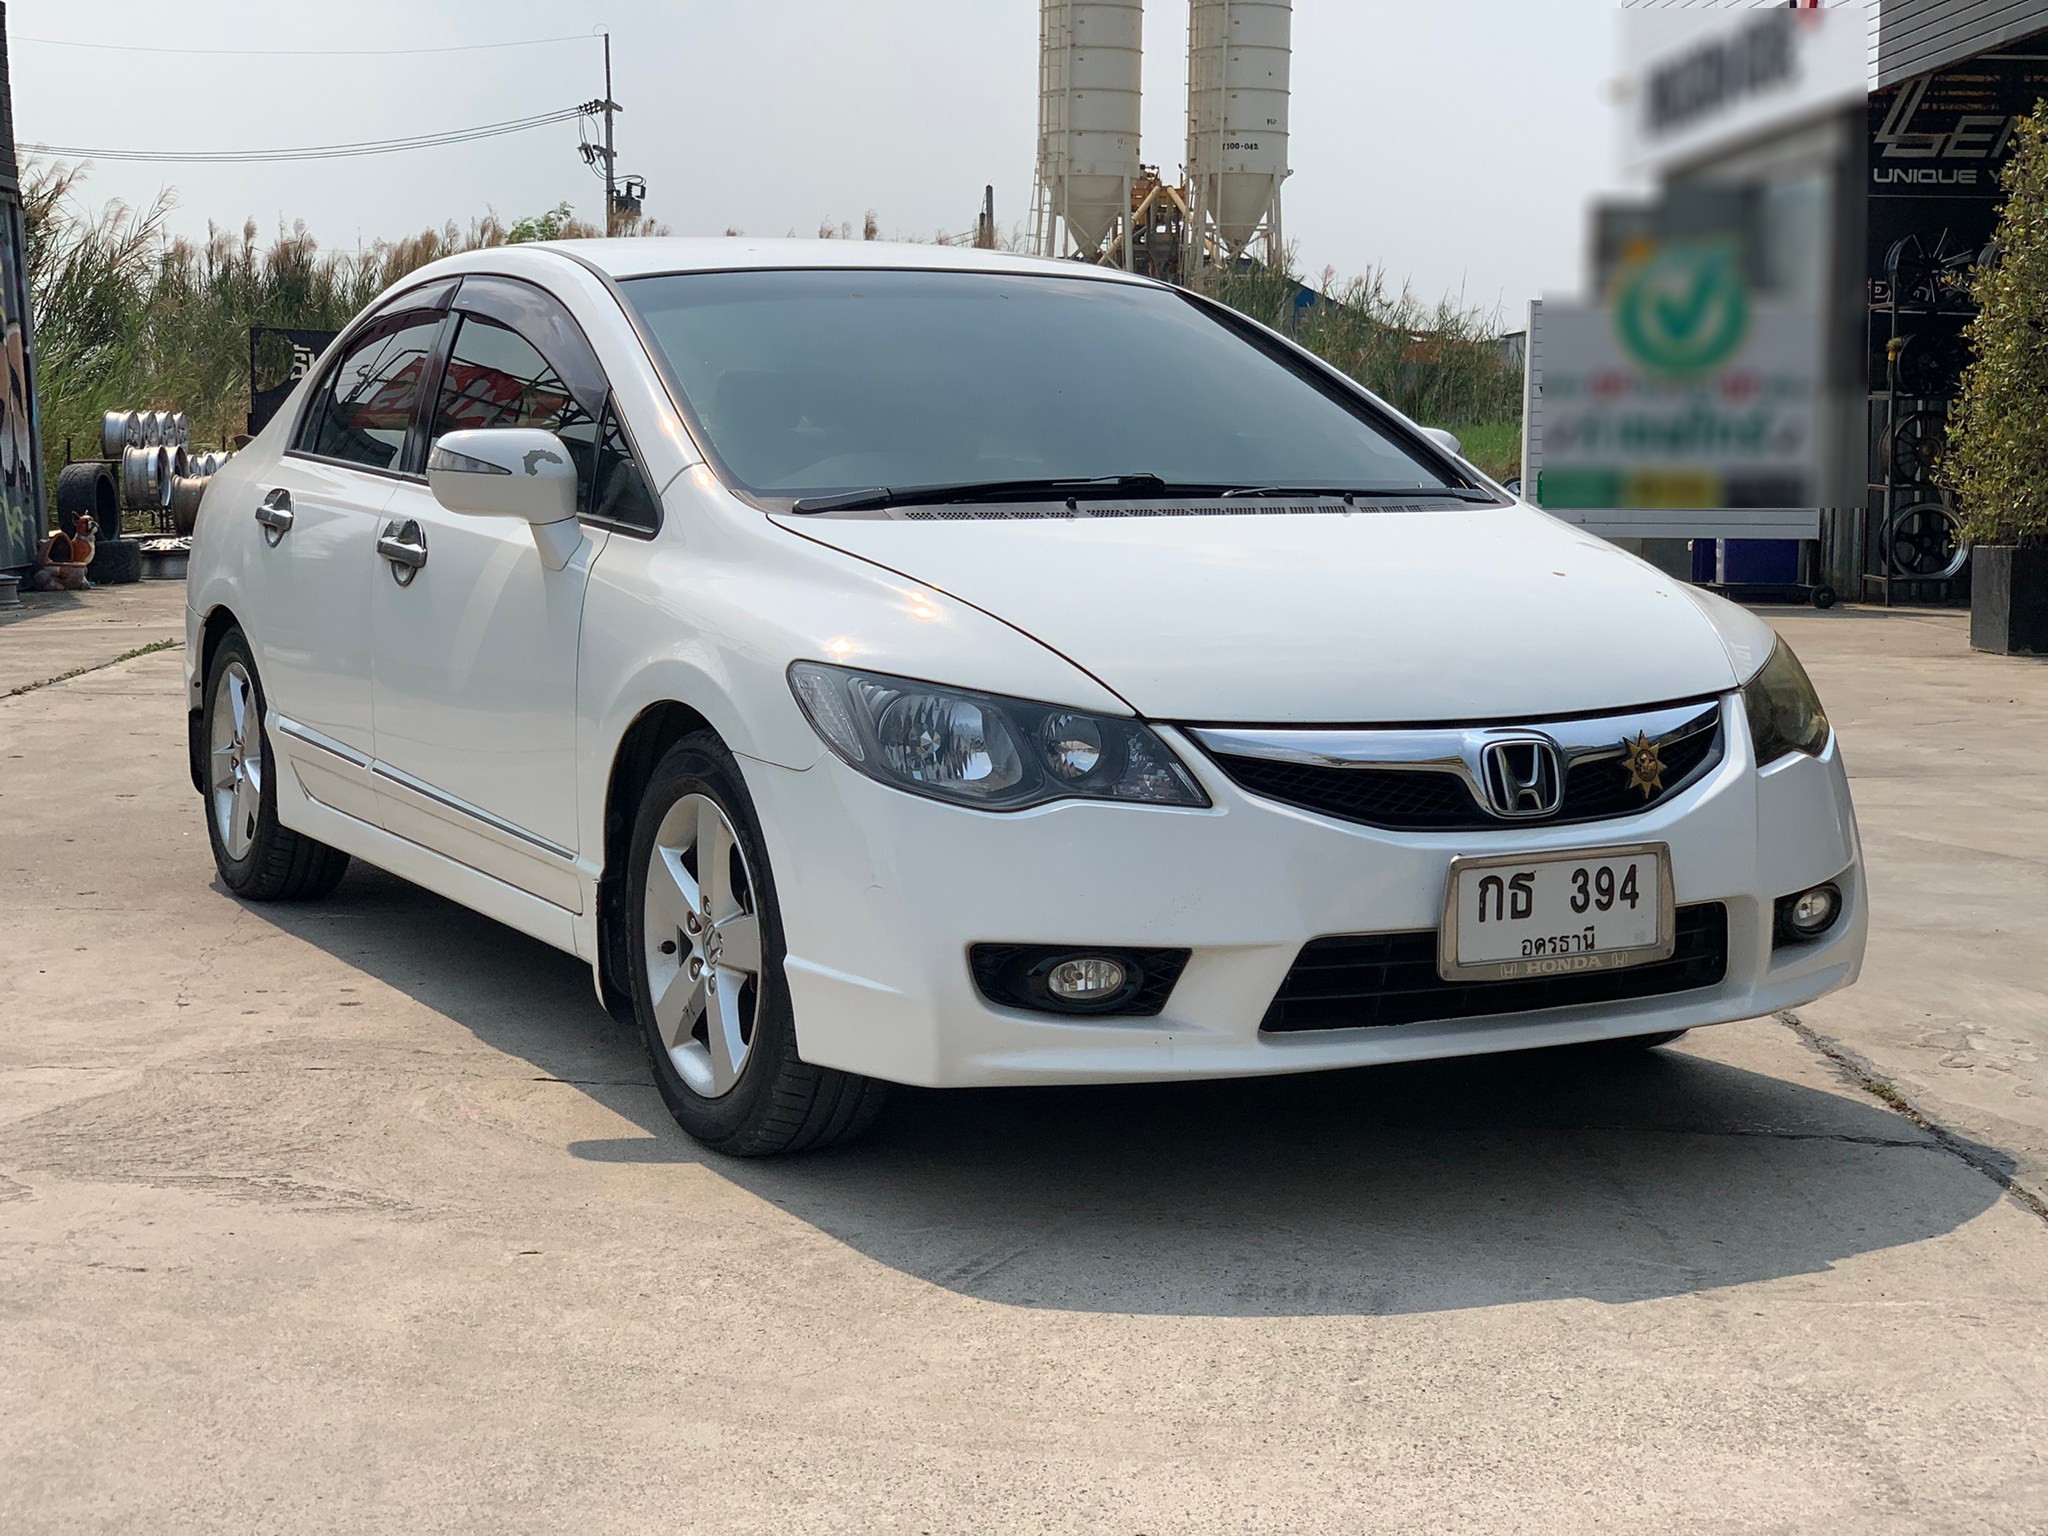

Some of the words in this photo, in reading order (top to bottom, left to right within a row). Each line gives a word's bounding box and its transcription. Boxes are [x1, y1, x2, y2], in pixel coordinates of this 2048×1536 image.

[1873, 168, 1977, 184] UNIQUE
[1478, 871, 1536, 922] กธ
[1570, 864, 1640, 914] 394
[1525, 956, 1603, 975] HONDA
